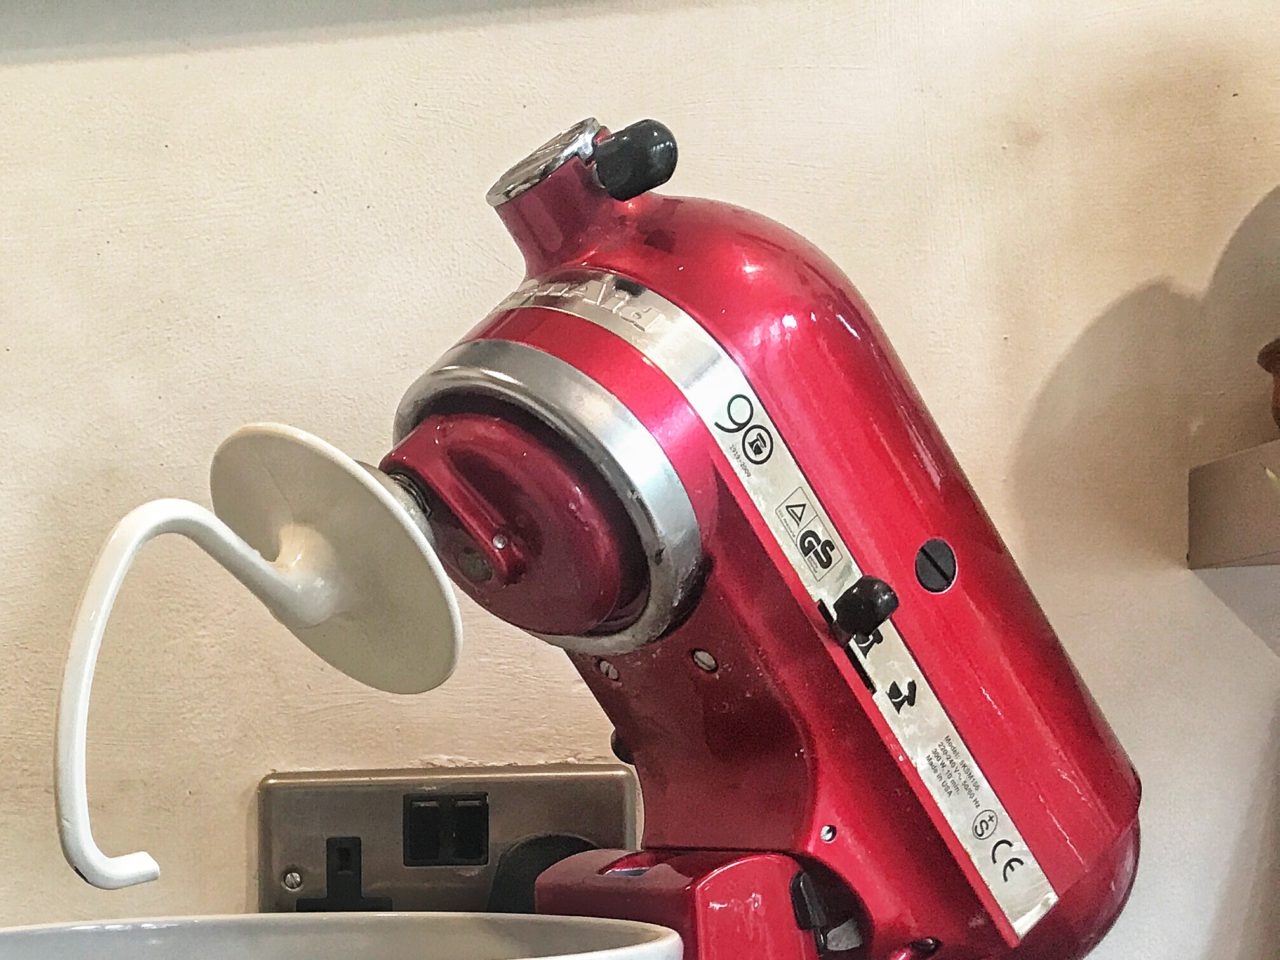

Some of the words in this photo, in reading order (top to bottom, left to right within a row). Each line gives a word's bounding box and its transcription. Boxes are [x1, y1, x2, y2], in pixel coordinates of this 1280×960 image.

[799, 530, 836, 569] GS
[944, 735, 960, 759] Model:
[926, 754, 938, 774] Made
[936, 772, 943, 782] in
[941, 780, 953, 797] USA
